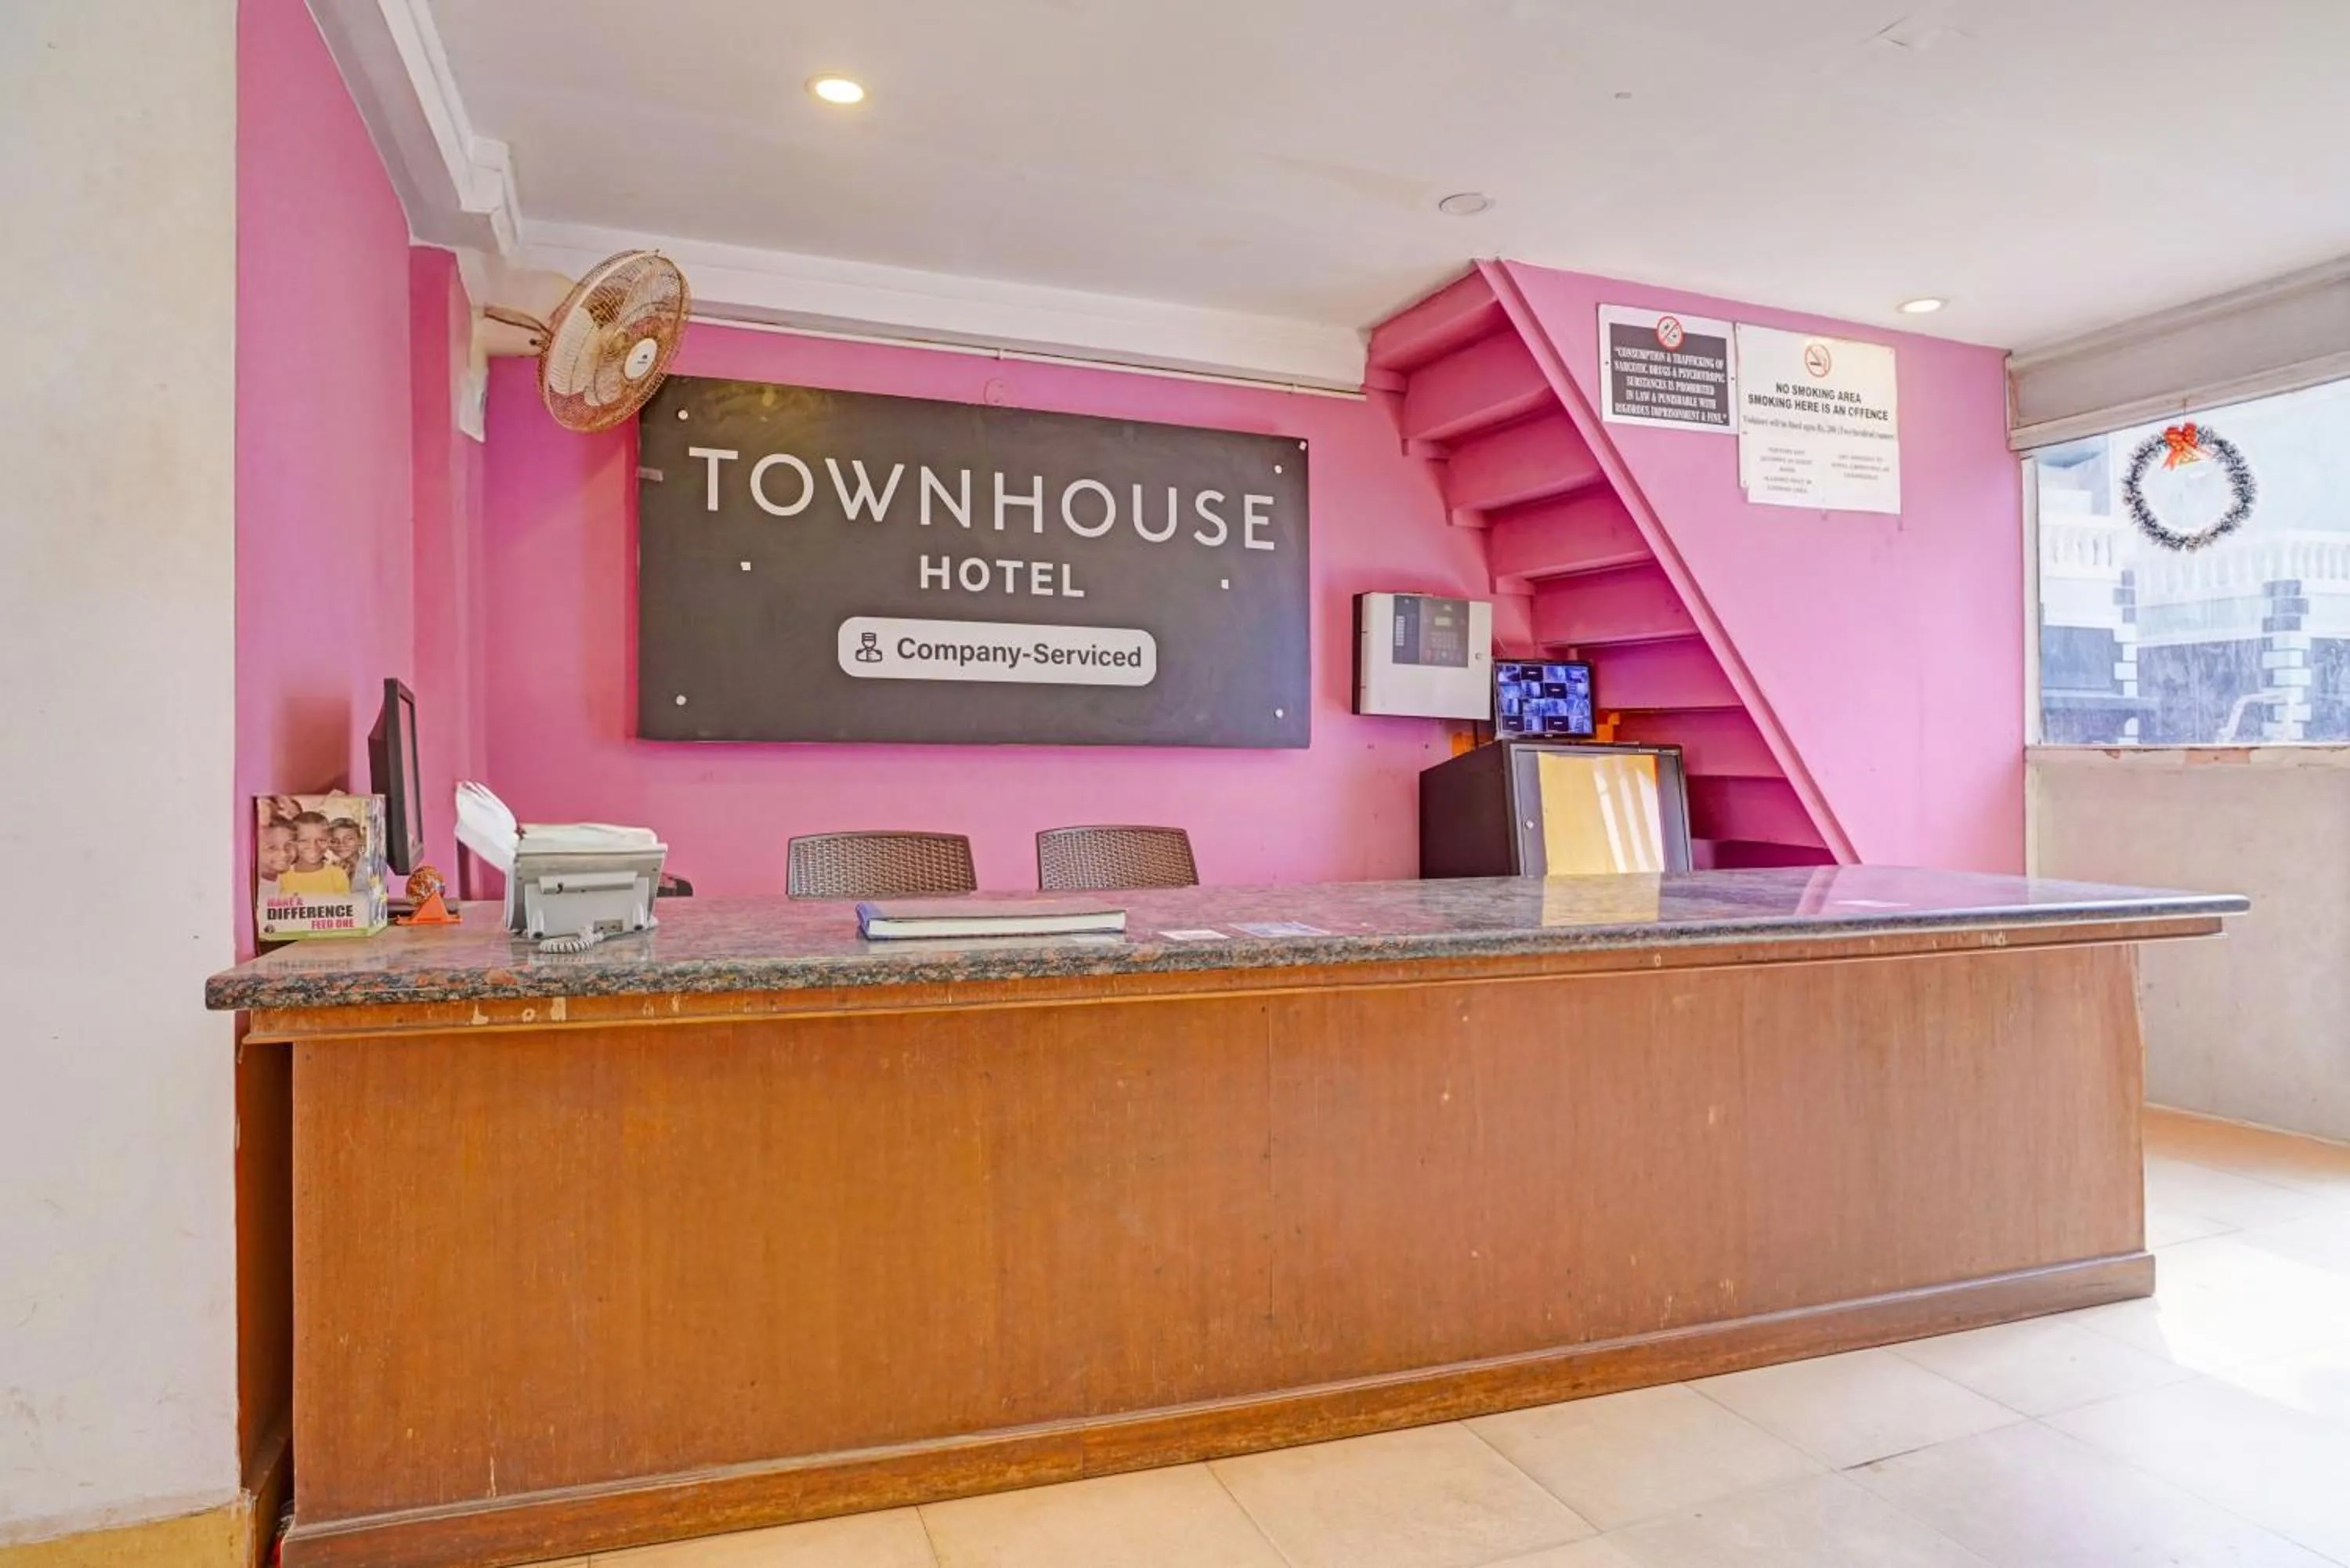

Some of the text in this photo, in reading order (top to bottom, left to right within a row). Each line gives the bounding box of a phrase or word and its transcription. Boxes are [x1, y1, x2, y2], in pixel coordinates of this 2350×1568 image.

[1776, 382, 1861, 403] NO SMOKING AREA
[1748, 394, 1791, 409] SMOKING
[1795, 400, 1819, 413] HERE
[1821, 403, 1831, 414] IS
[1833, 405, 1846, 416] AN
[689, 446, 1276, 550] TOWNHOUSE
[920, 555, 1085, 598] HOTEL
[897, 637, 1141, 667] Company-Serviced
[267, 905, 353, 920] DIFFERENCE
[312, 919, 355, 930] FEED ONE
